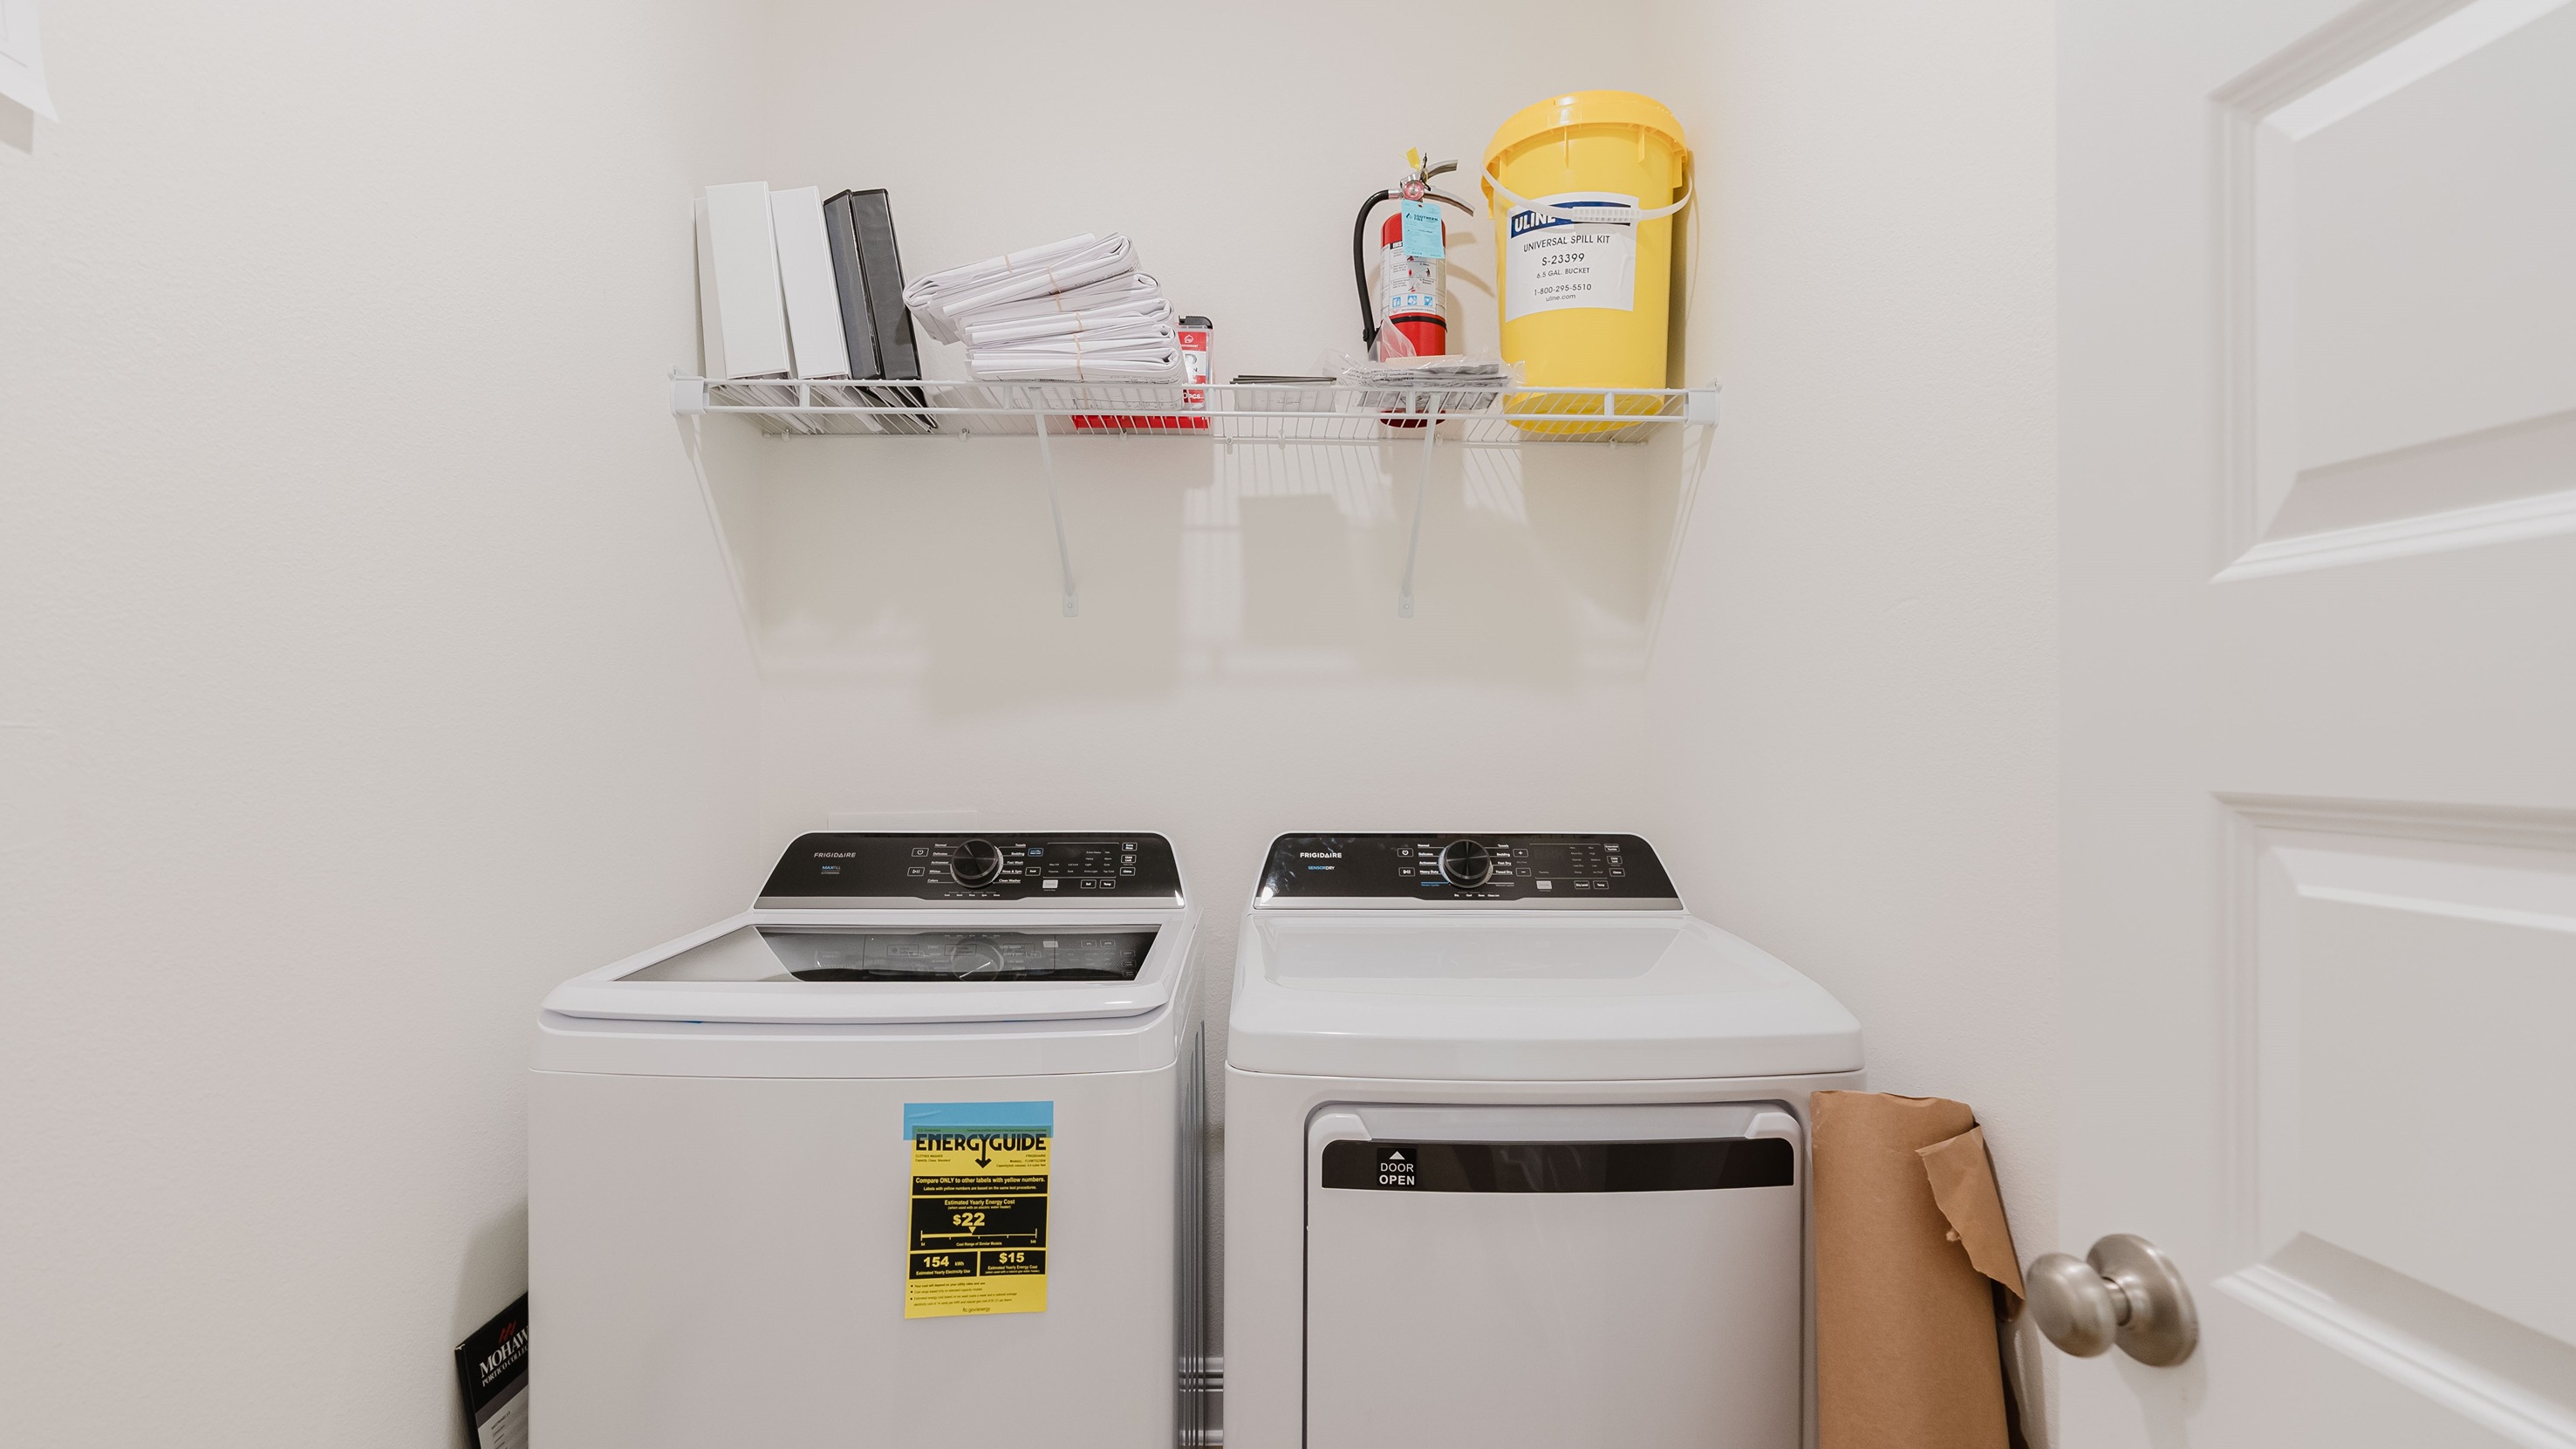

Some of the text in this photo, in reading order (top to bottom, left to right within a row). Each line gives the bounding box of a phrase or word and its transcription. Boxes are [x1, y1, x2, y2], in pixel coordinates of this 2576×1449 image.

[1514, 212, 1556, 232] ULINE
[1523, 235, 1610, 252] UNIVERSAL SPILL KIT
[1541, 253, 1585, 266] S-23399
[1534, 284, 1592, 296] 1-800-295-5510
[916, 1133, 1047, 1152] ENERGYGUIDE
[1380, 1163, 1414, 1172] DOOR
[1379, 1174, 1415, 1186] OPEN
[953, 1212, 985, 1227] $22
[923, 1255, 949, 1268] 154
[999, 1252, 1025, 1264] $15
[482, 1362, 508, 1387] PORTICO
